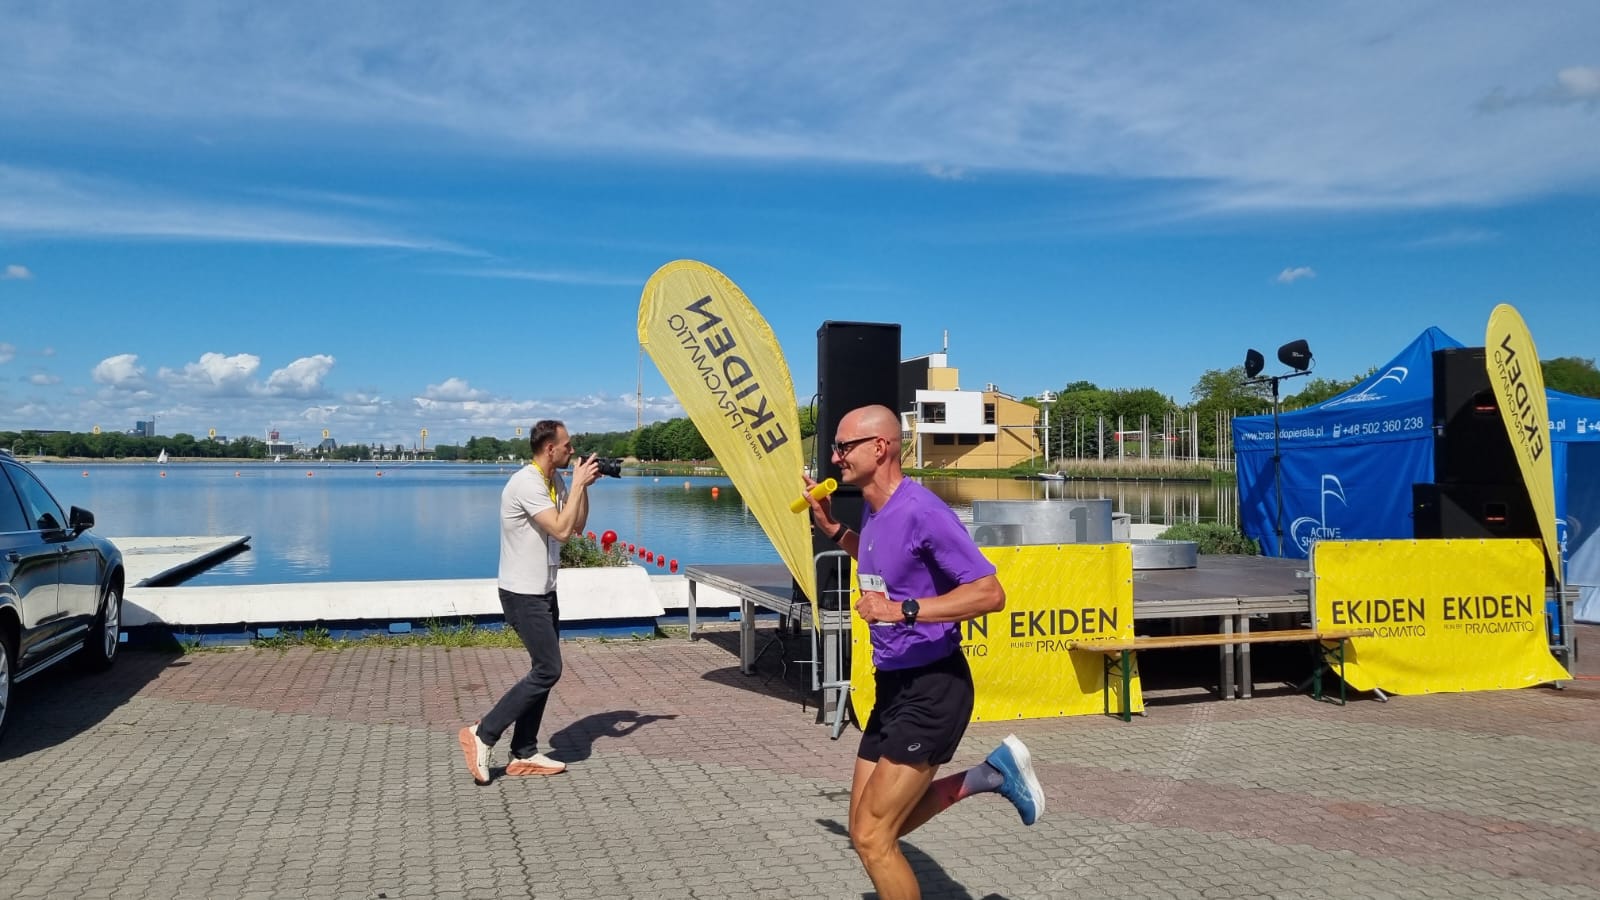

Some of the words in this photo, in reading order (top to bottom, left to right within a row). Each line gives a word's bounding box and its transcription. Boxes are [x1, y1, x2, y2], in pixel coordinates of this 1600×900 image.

[1343, 423, 1360, 436] +48
[1362, 421, 1380, 435] 502
[1382, 419, 1401, 433] 360
[1403, 416, 1424, 430] 238
[1069, 506, 1088, 543] 1
[1310, 527, 1341, 538] ACTIVE
[1332, 597, 1425, 625] EKIDEN
[1443, 594, 1533, 620] EKIDEN
[1010, 607, 1117, 638] EKIDEN
[1010, 641, 1024, 649] RUN
